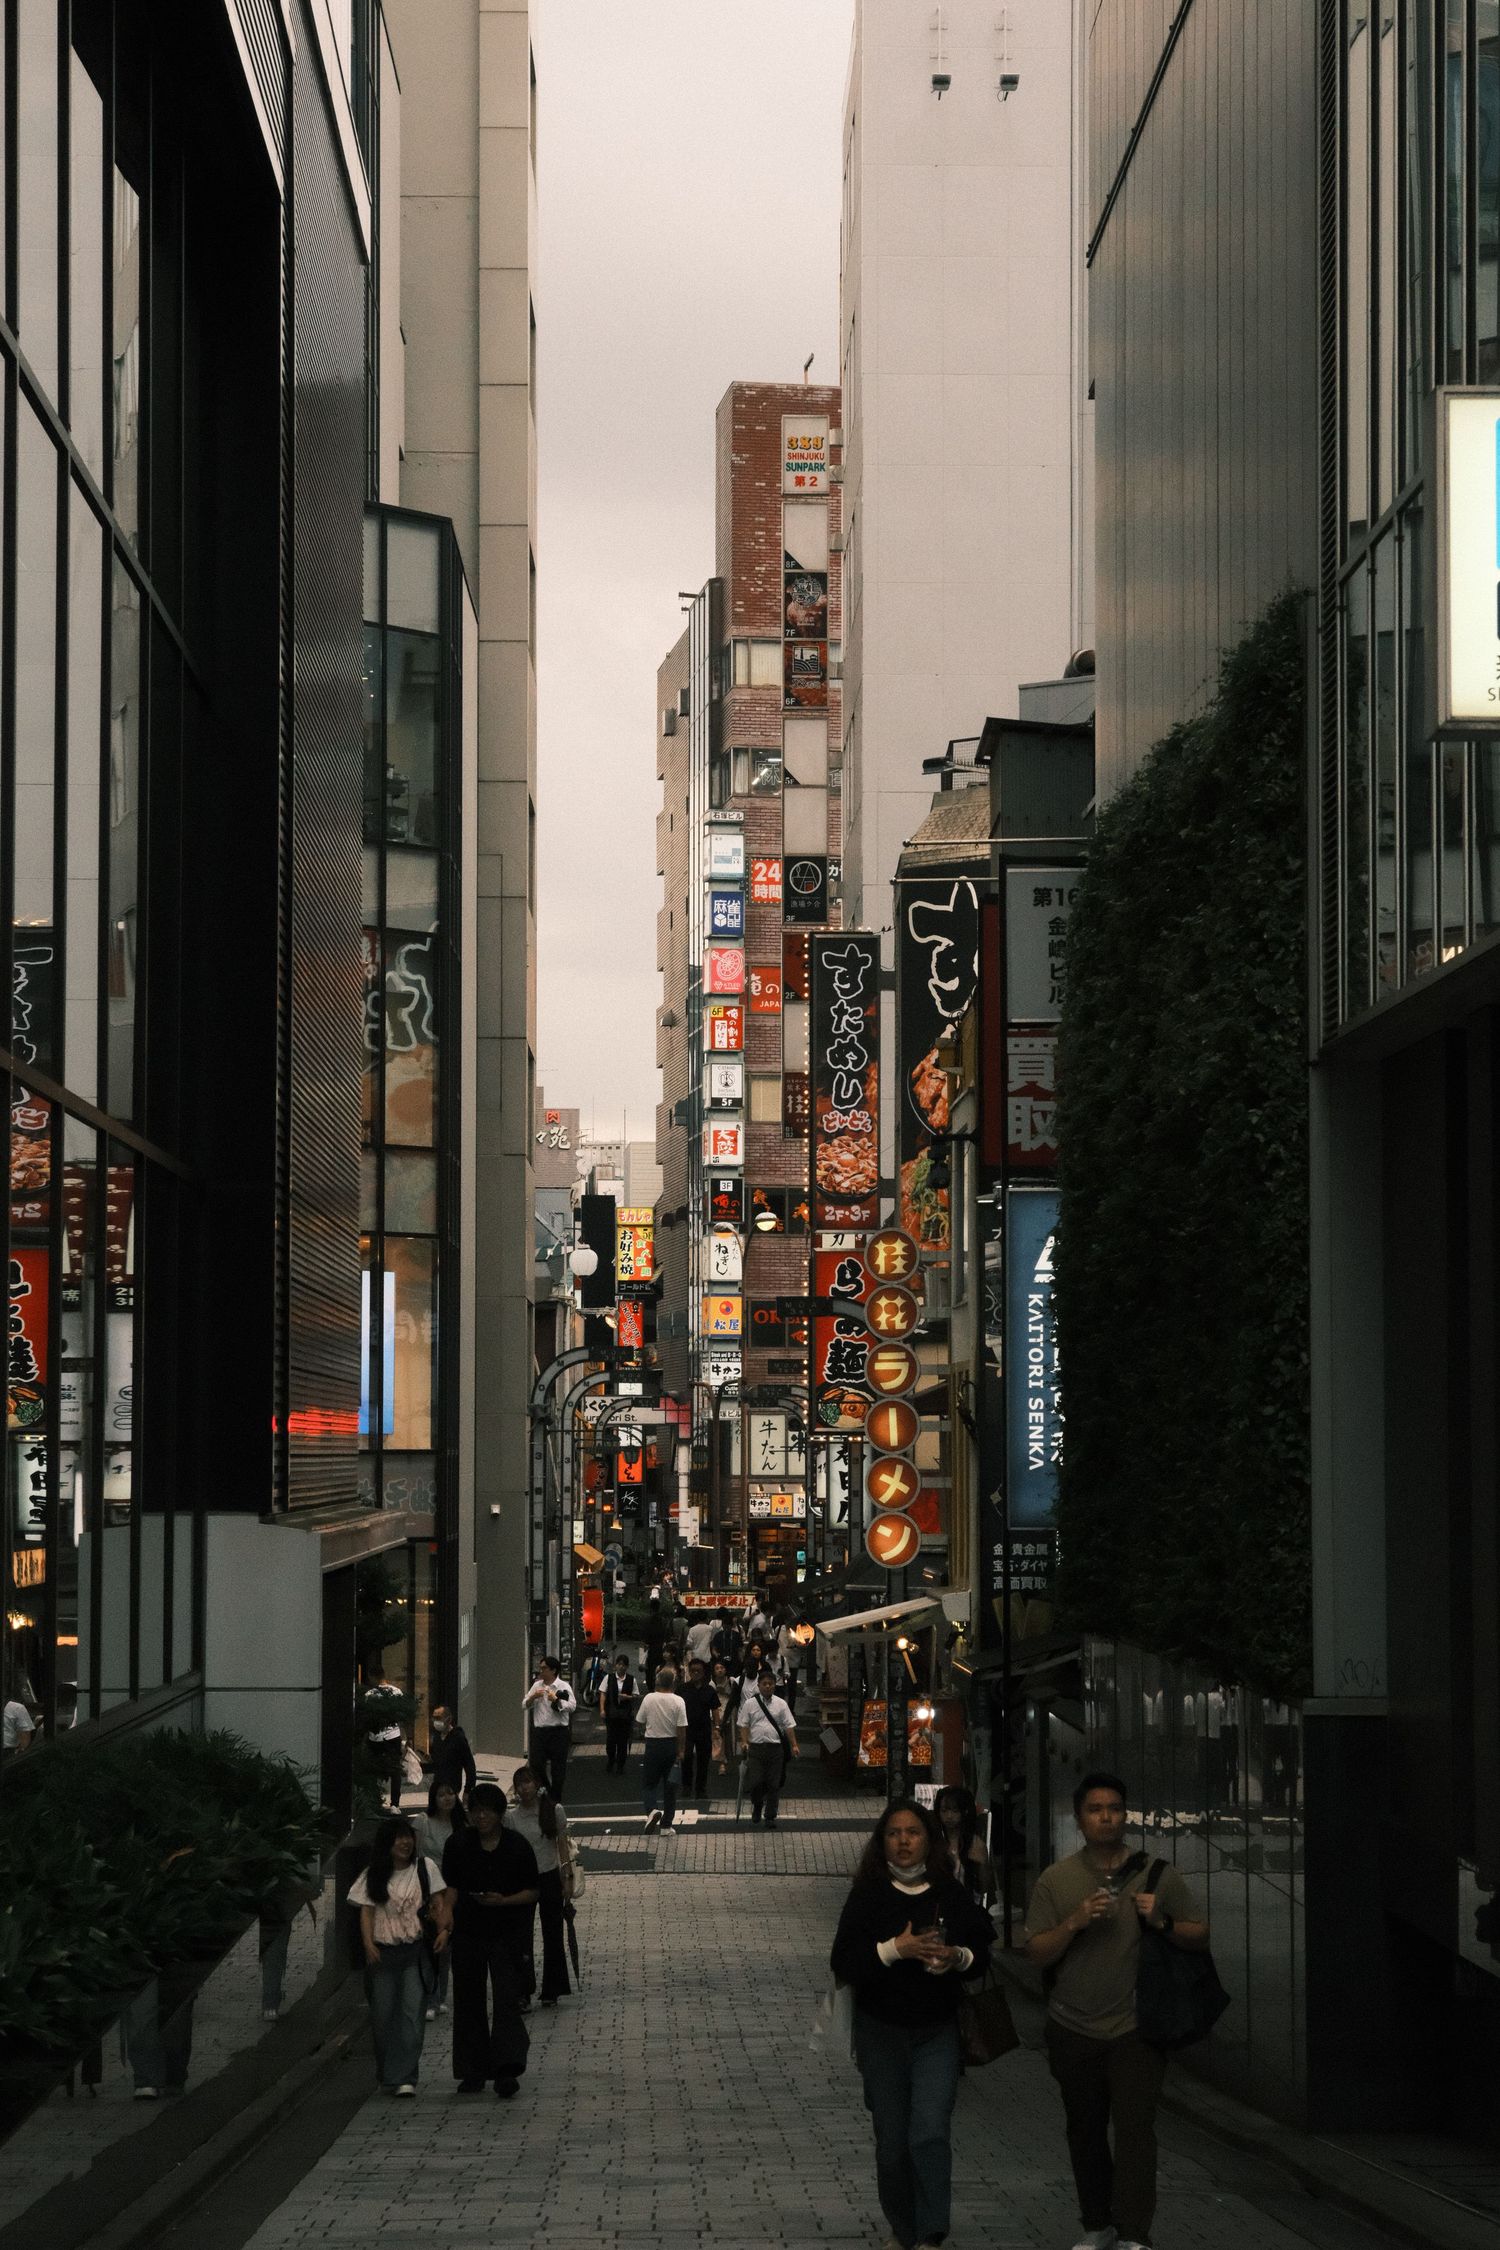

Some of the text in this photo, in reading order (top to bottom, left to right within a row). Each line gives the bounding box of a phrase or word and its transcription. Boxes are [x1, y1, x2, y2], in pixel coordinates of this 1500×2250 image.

[787, 452, 825, 460] SHINJUKU
[785, 462, 826, 472] SUNPARK
[785, 629, 796, 637] 7F
[785, 697, 796, 705] 6F
[712, 811, 743, 820] 石塚ビル
[754, 862, 782, 882] 24
[754, 884, 783, 899] 時間
[714, 899, 741, 913] 麻雀
[784, 991, 796, 1000] 2F
[759, 1000, 782, 1008] JAPA
[712, 1008, 722, 1017] 6F
[821, 943, 873, 1110] すためし
[1007, 1037, 1059, 1152] 買取
[721, 1097, 733, 1106] 5F
[545, 1111, 560, 1124] 肉
[822, 1109, 873, 1134] どんどん
[535, 1125, 571, 1149] 々苑
[721, 1181, 732, 1190] 3F
[712, 1193, 741, 1209] 俺の
[618, 1206, 652, 1223] もんじゃ
[619, 1229, 634, 1276] お好み焼
[715, 1242, 728, 1275] ねぎし
[714, 1318, 740, 1331] 松屋
[711, 1363, 741, 1376] 牛かつ
[624, 1413, 638, 1422] St.
[758, 1419, 778, 1471] 牛たん
[750, 1499, 770, 1507] 牛かつ
